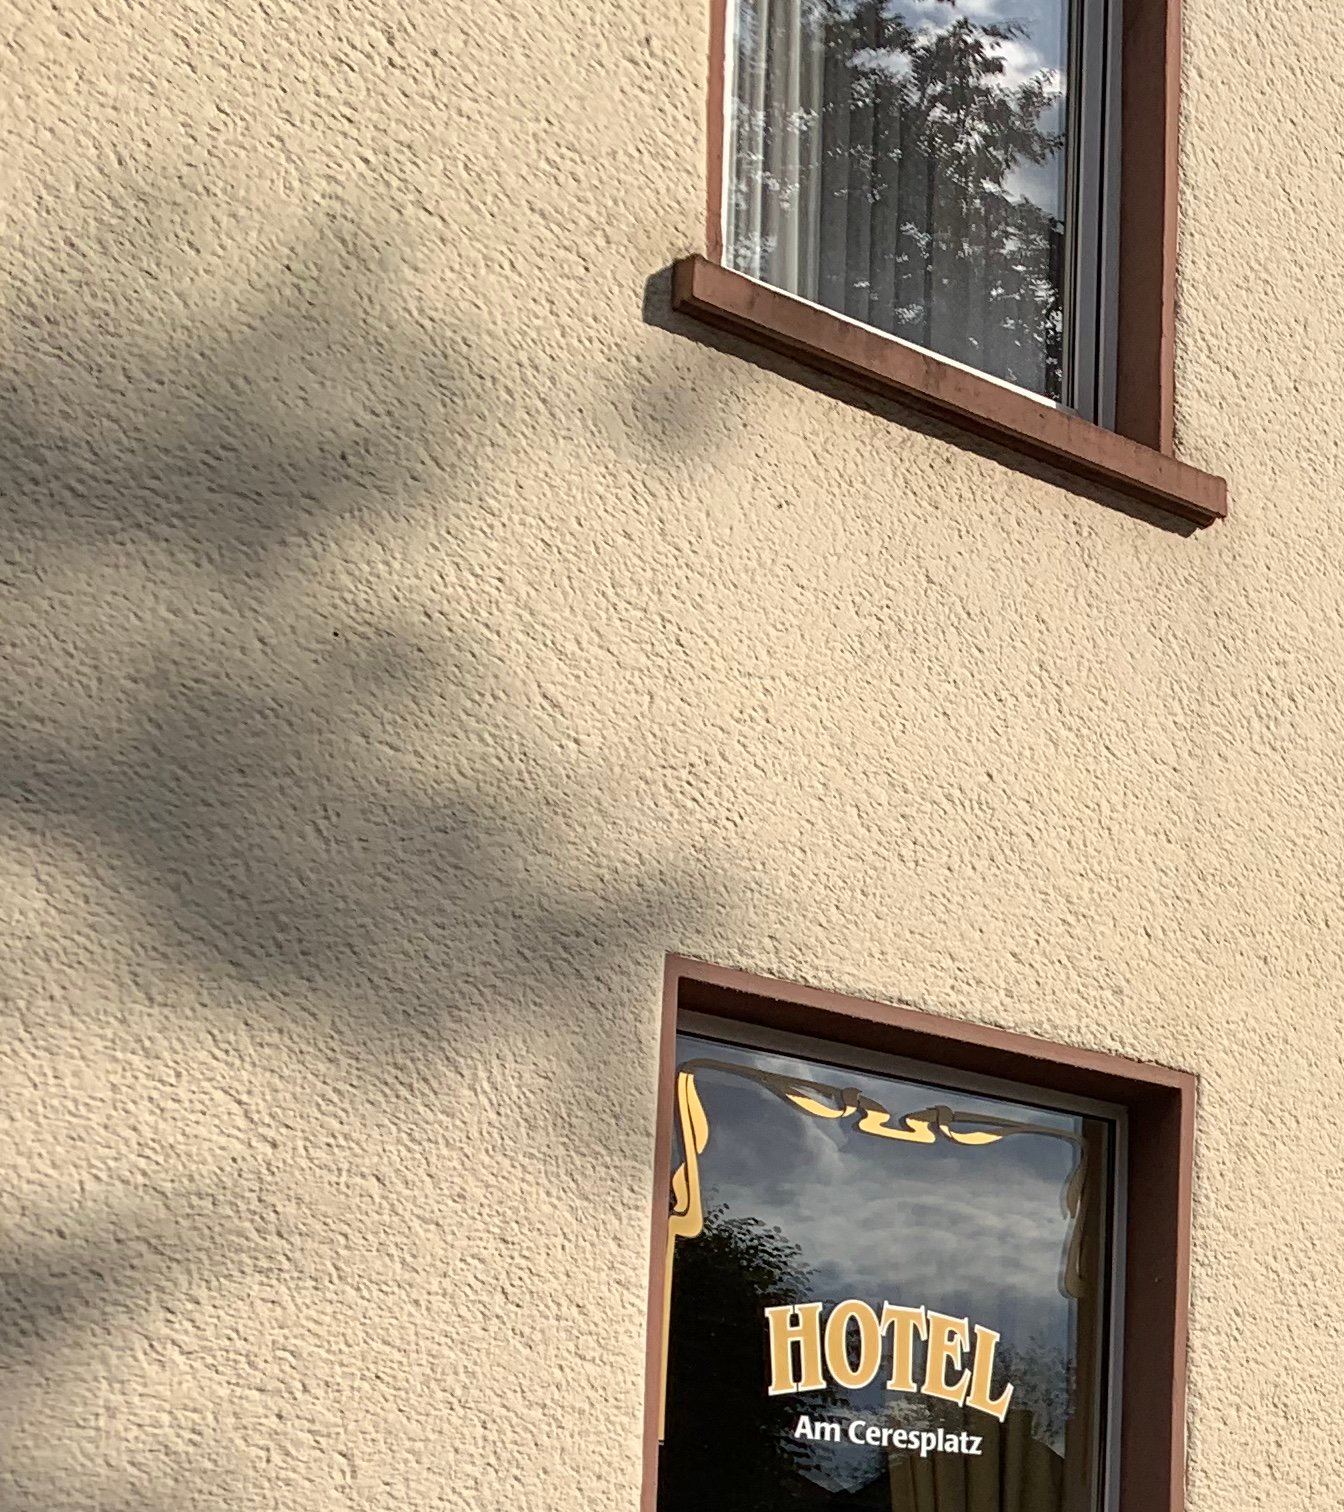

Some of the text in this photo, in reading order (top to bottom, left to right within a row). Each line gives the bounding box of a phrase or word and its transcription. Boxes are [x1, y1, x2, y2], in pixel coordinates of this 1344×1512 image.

[765, 1300, 1014, 1422] HOTEL
[794, 1415, 983, 1457] Am Ceresplatz
